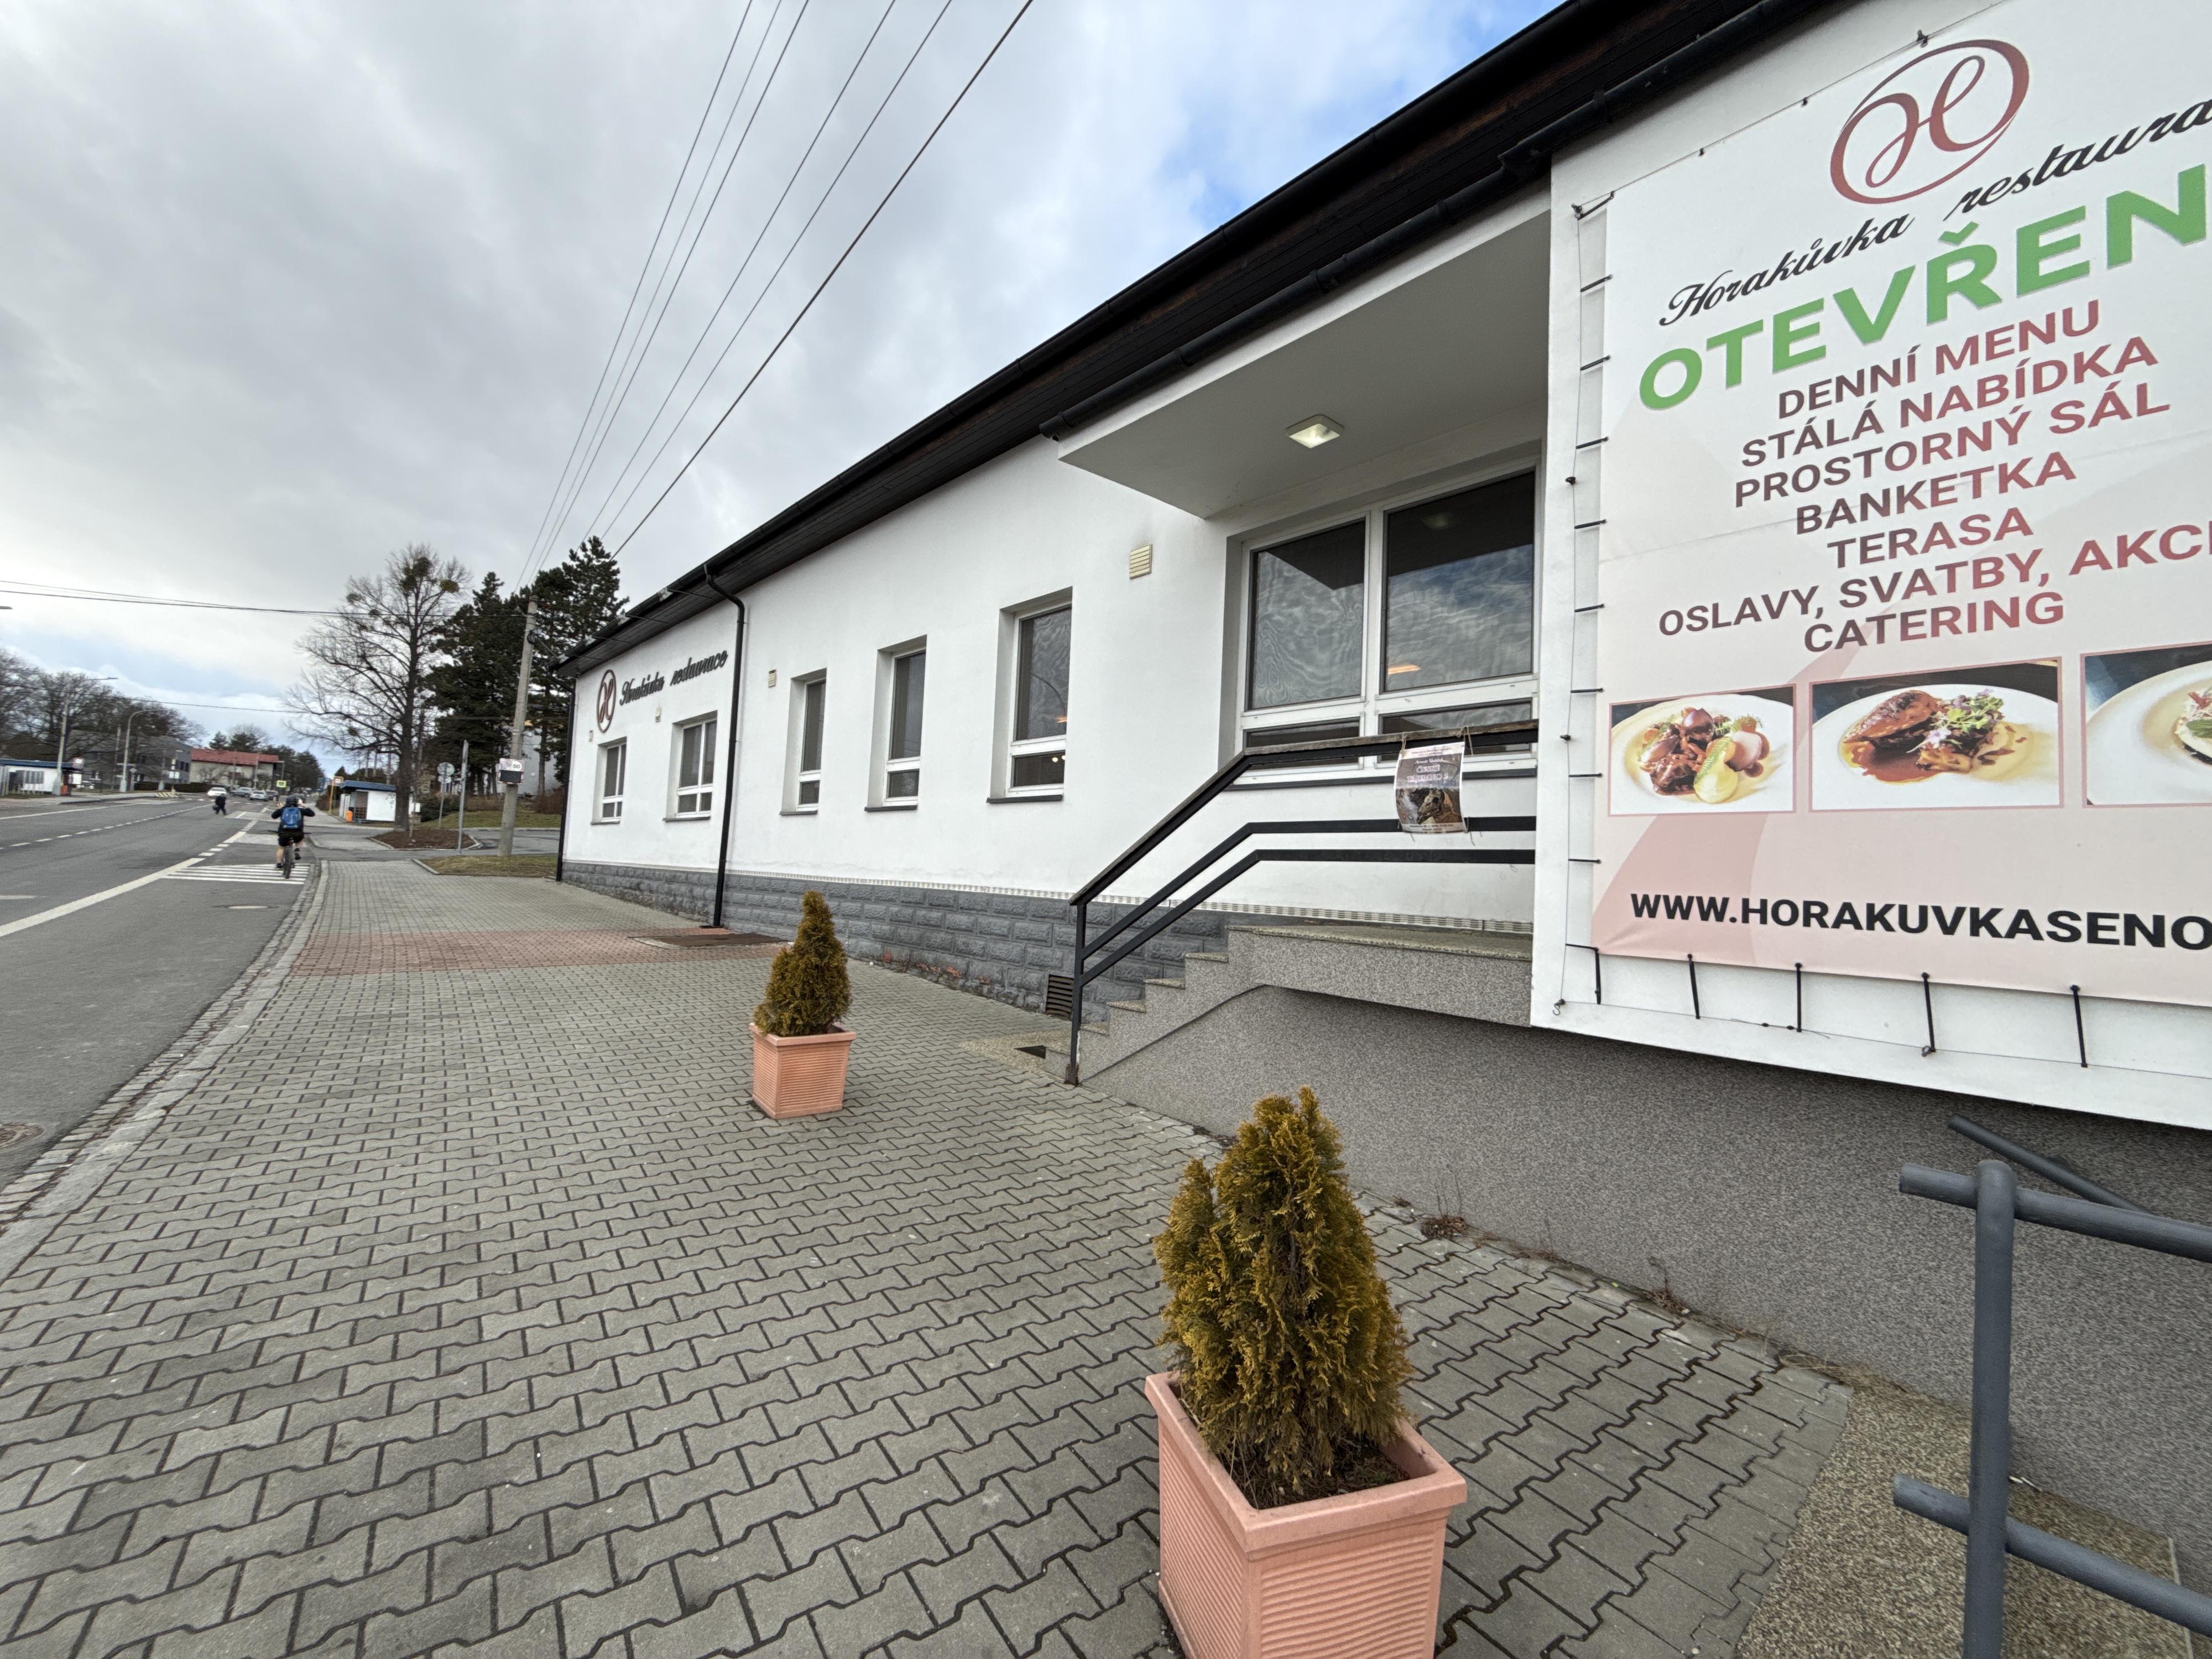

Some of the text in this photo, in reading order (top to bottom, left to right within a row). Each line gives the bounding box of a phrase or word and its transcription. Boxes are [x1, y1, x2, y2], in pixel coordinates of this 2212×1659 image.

[1658, 98, 2212, 326] Horakůvka restaura
[1639, 164, 2206, 410] OTEVŘEN
[1741, 336, 2158, 467] STÁLÁ NABÍDKA
[1778, 299, 2099, 419] DENNÍ MENU
[1735, 380, 2171, 508] PROSTORNÝ SÁL
[1796, 451, 2076, 535] BANKETKA
[1658, 520, 2212, 636] OSLAVY, SVATBY, AKC
[1827, 507, 2033, 568] TERASA
[670, 650, 728, 686] restaurace
[1803, 591, 2065, 653] CATERING
[1630, 893, 2212, 951] WWW.HORAKUVKASENO
